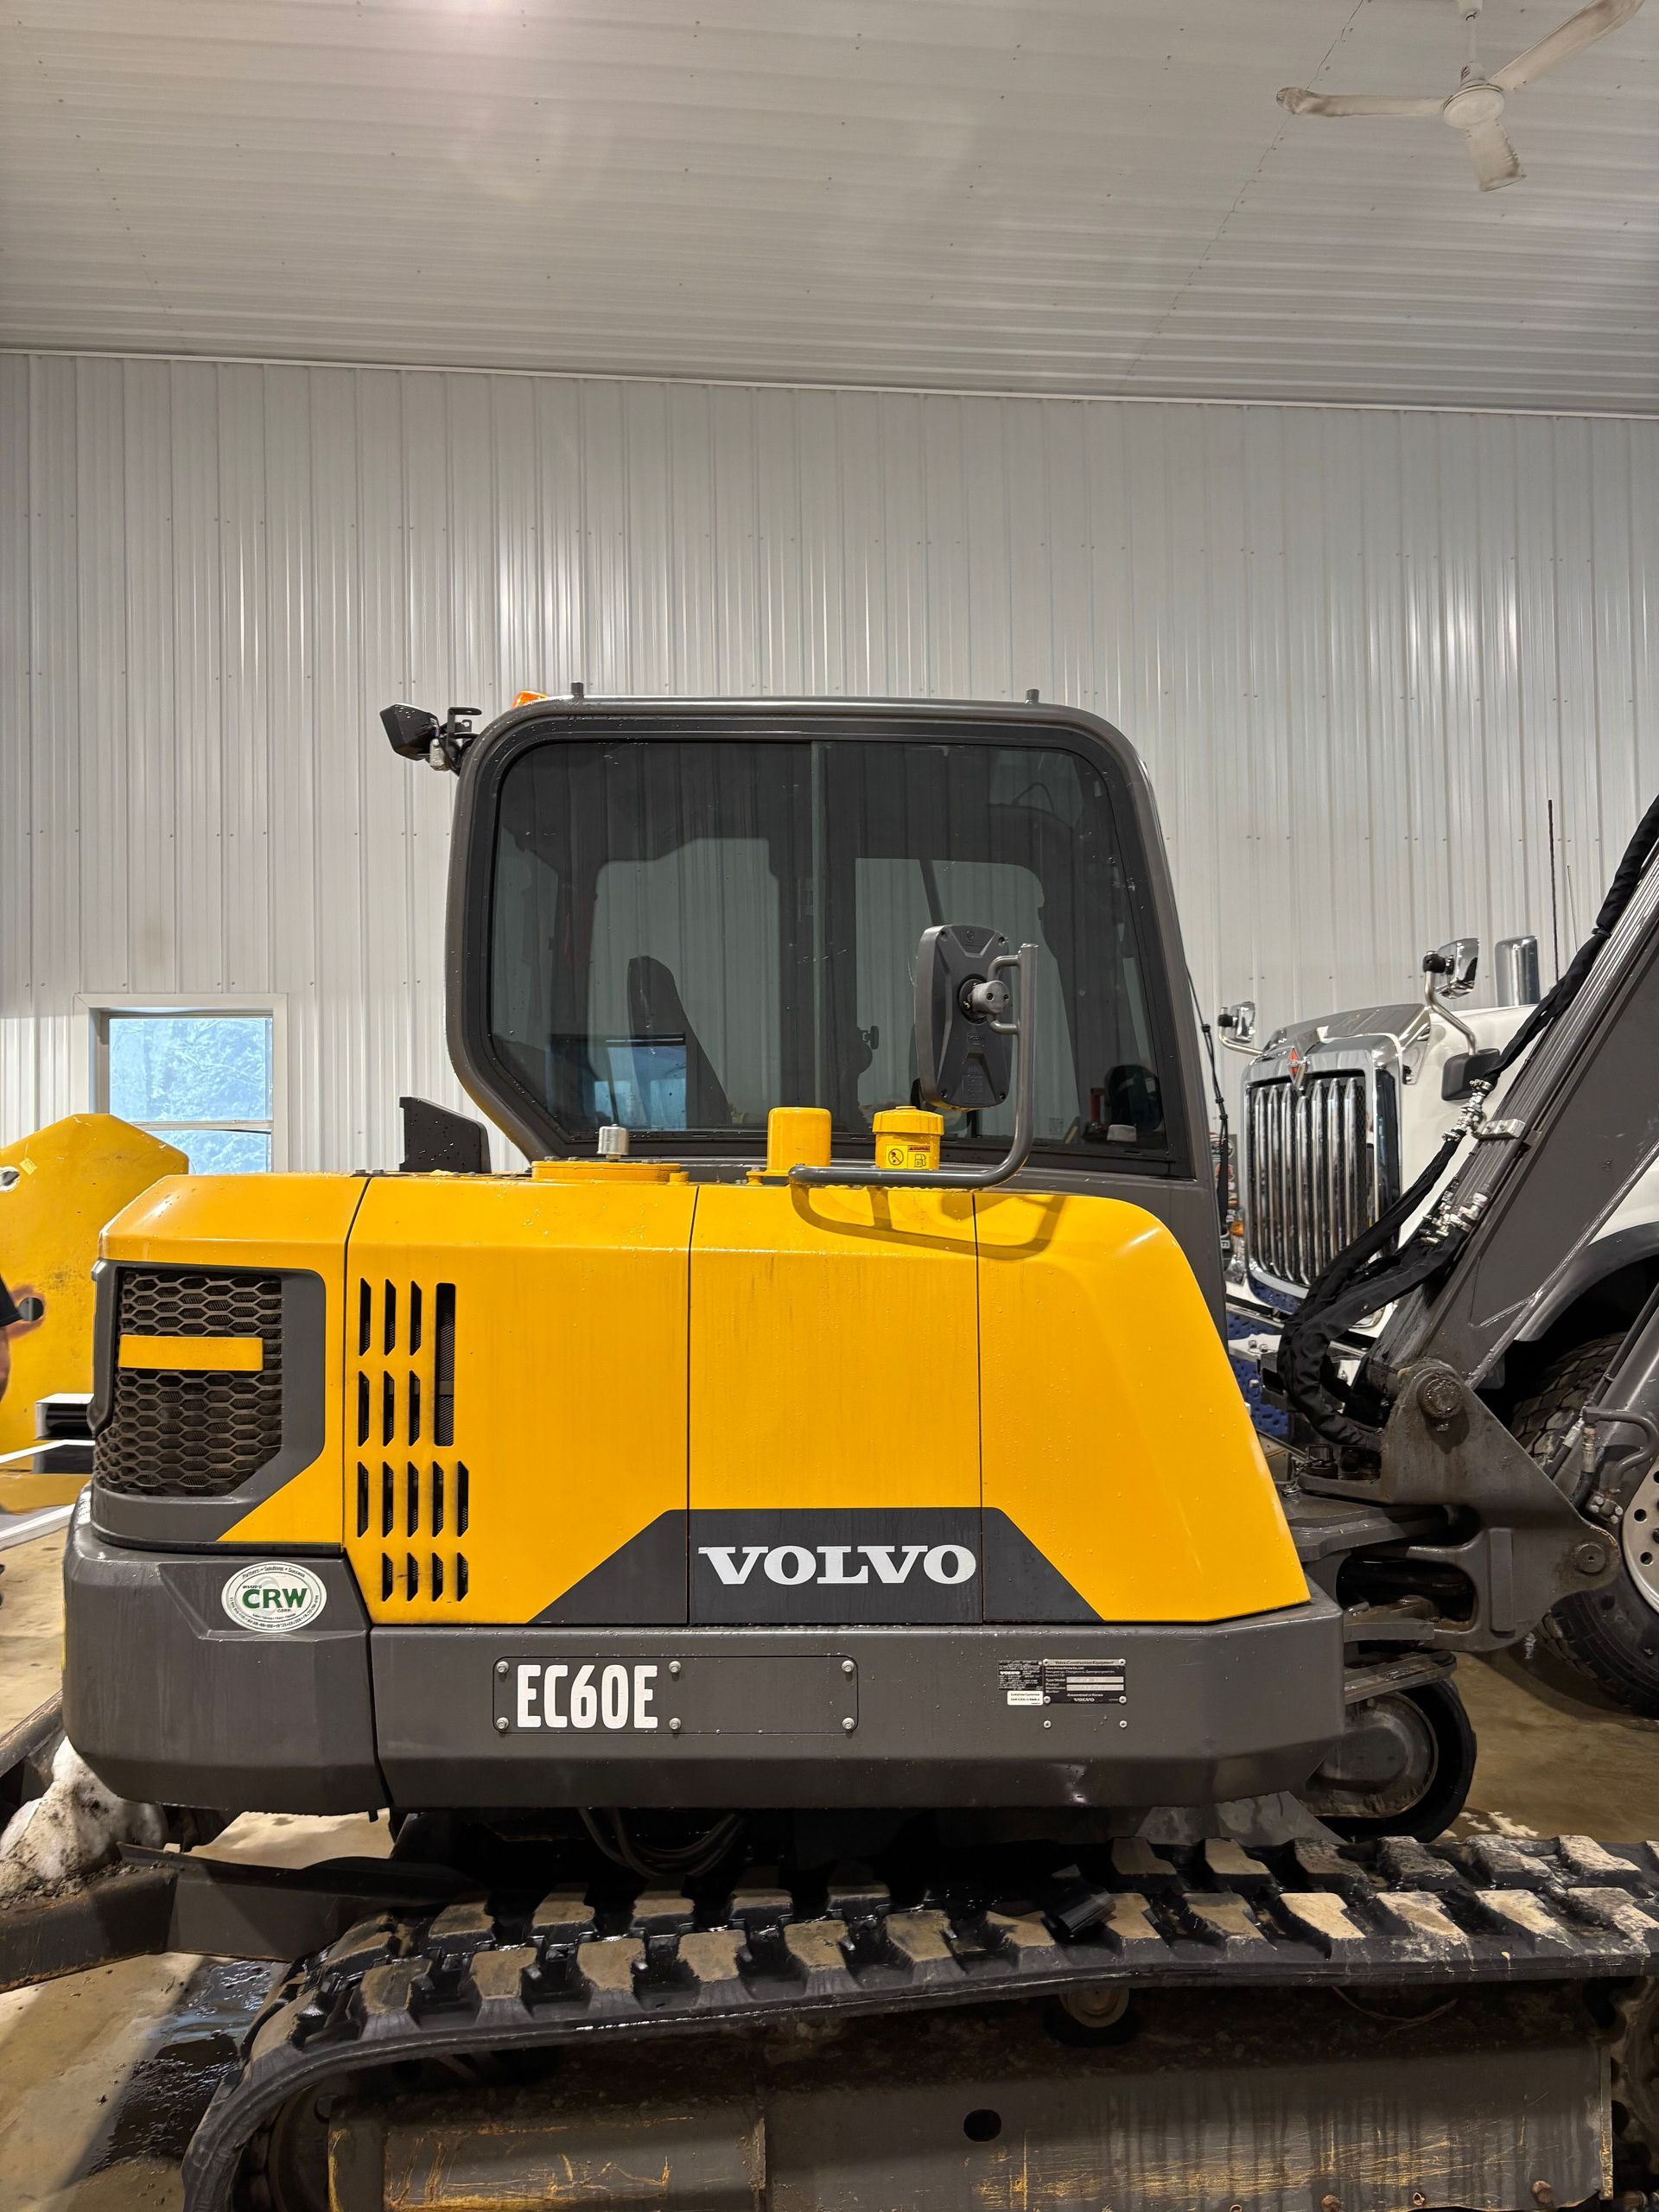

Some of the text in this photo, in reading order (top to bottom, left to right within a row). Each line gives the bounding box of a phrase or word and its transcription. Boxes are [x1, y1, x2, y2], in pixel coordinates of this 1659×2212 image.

[697, 1544, 977, 1586] VOLVO
[243, 1589, 308, 1609] CRW
[517, 1663, 658, 1729] EC60E
